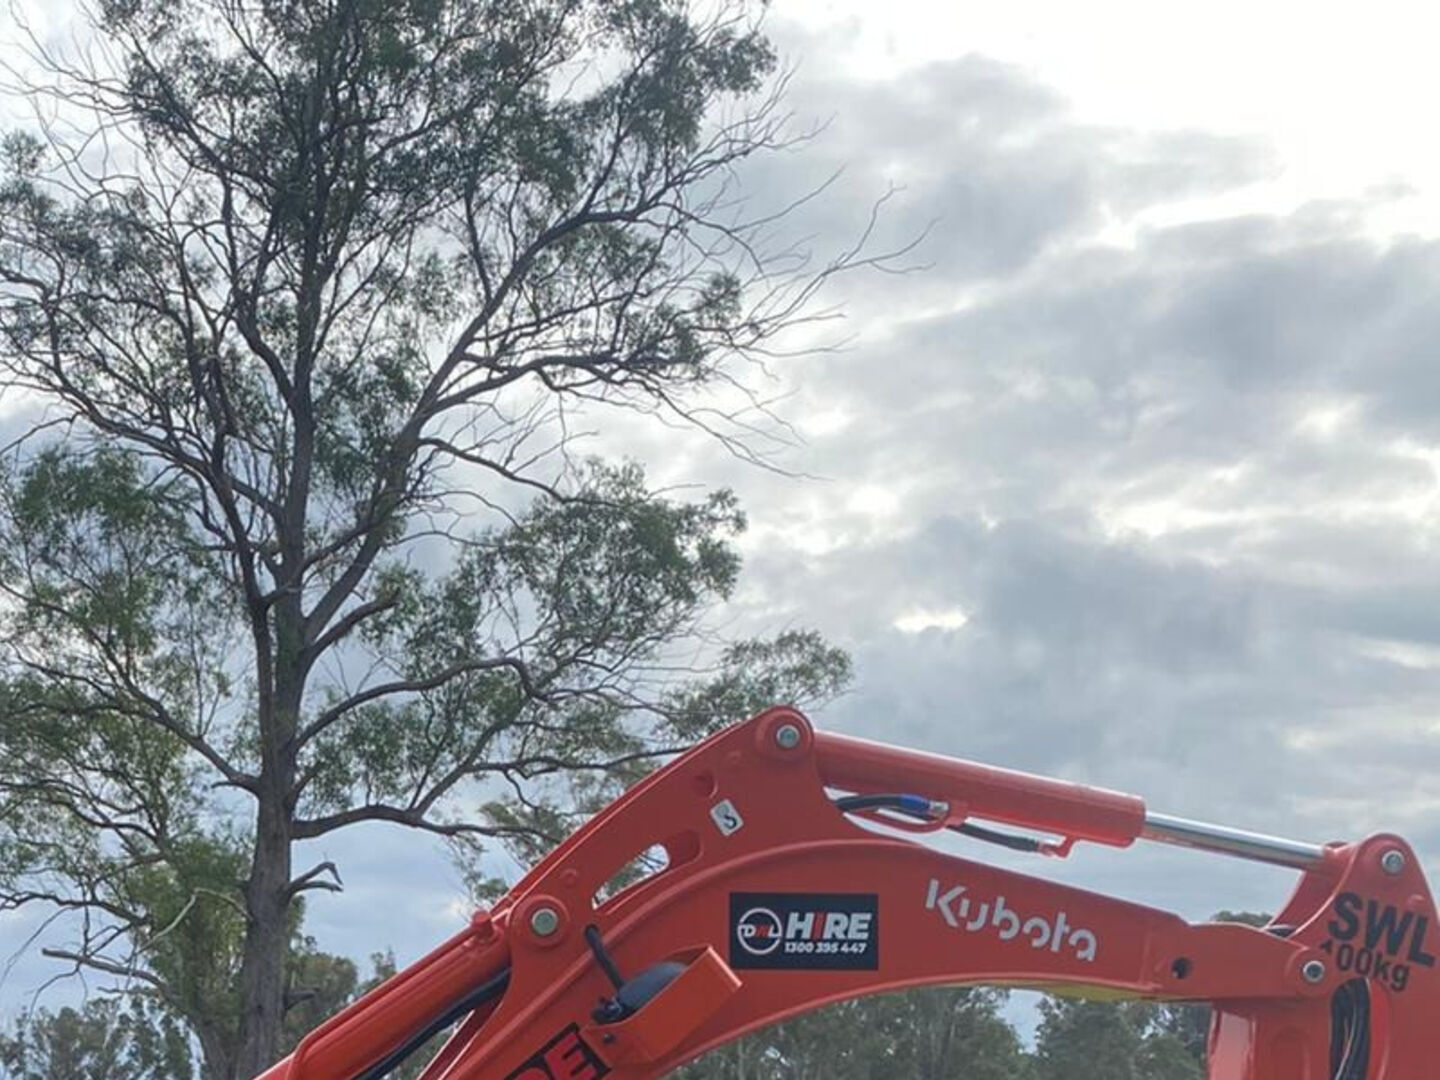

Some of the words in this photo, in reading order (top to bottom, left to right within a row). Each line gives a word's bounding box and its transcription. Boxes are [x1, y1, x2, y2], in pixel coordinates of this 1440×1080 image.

[785, 911, 873, 940] HIRE
[925, 878, 1098, 962] Kubota
[1329, 893, 1435, 966] SWL
[784, 941, 815, 954] 1300
[840, 941, 868, 954] 447
